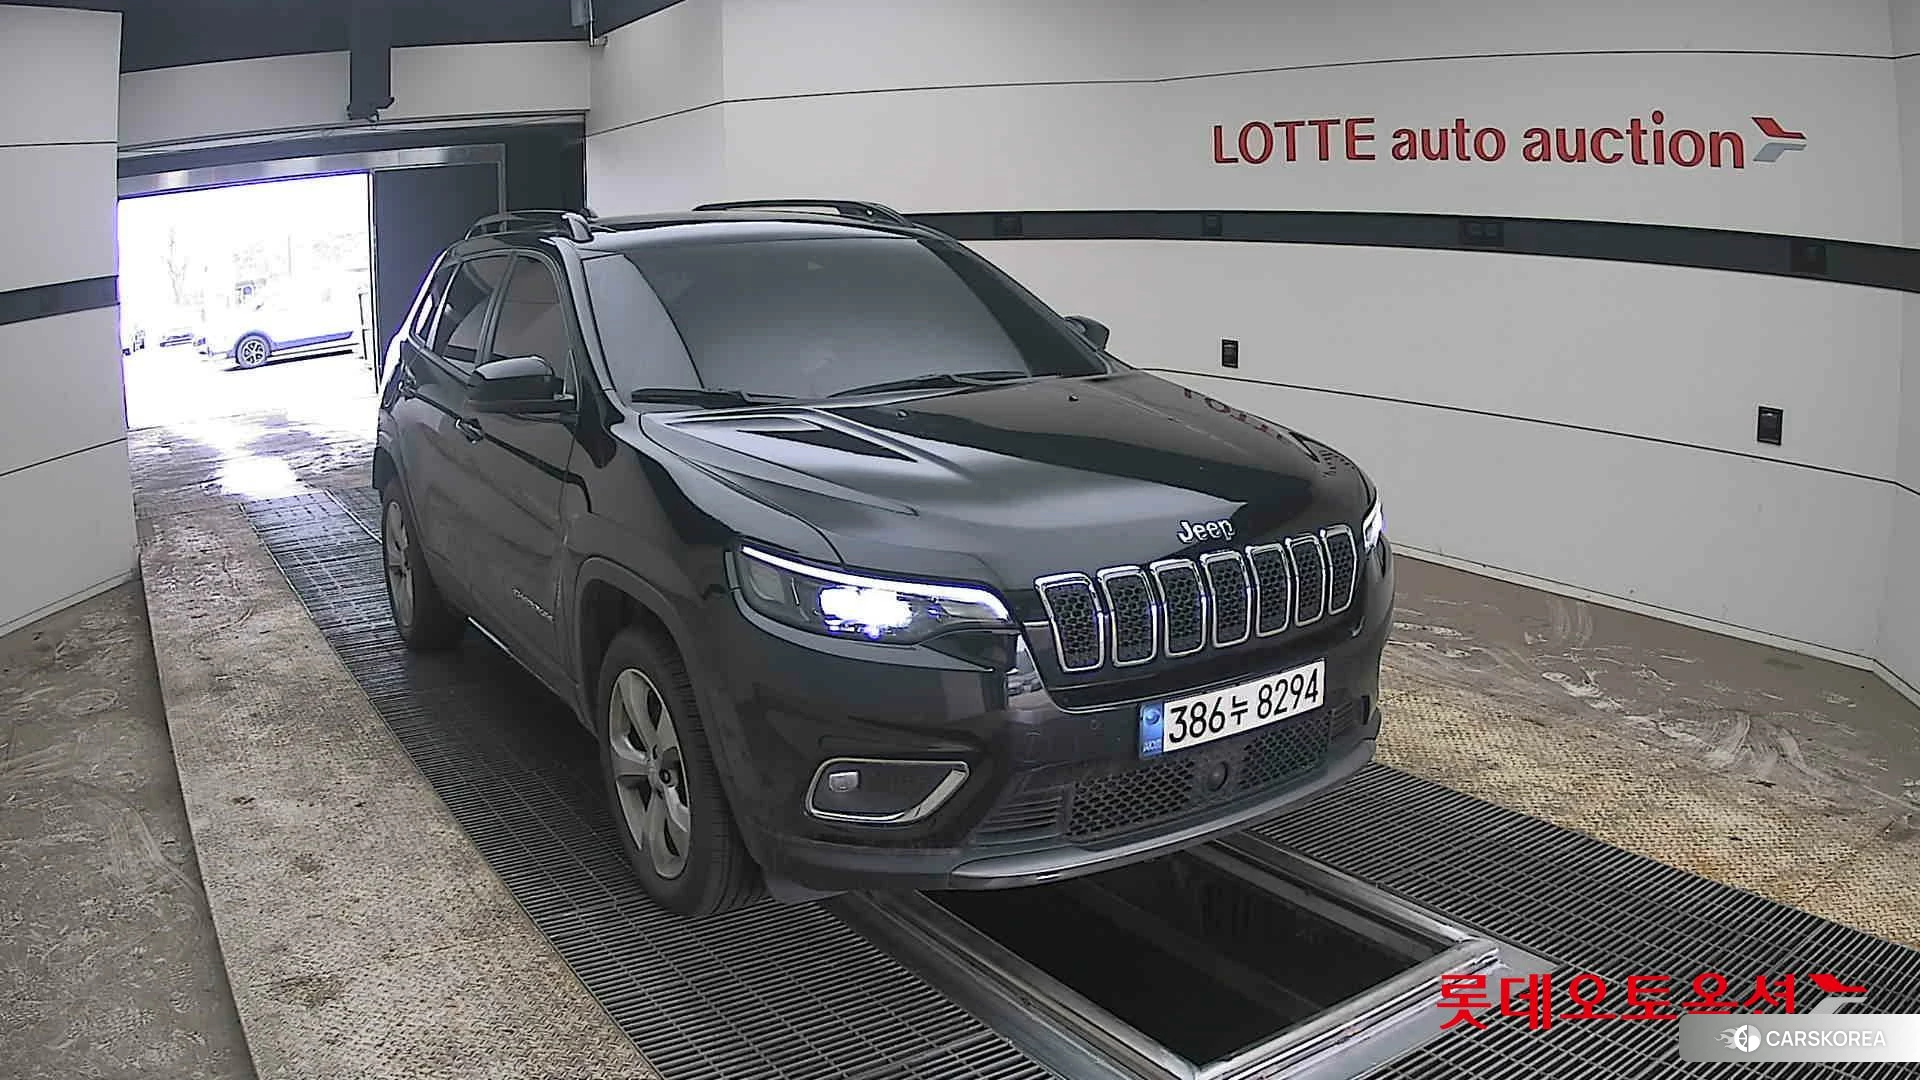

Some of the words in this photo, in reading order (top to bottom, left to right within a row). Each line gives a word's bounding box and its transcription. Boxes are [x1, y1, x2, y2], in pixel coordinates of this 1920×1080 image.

[1213, 117, 1377, 164] LOTTE
[1391, 118, 1506, 162] auto
[1522, 110, 1744, 169] auction
[1177, 519, 1235, 543] Jeep
[1168, 695, 1249, 744] 386누
[1256, 667, 1319, 720] 8294
